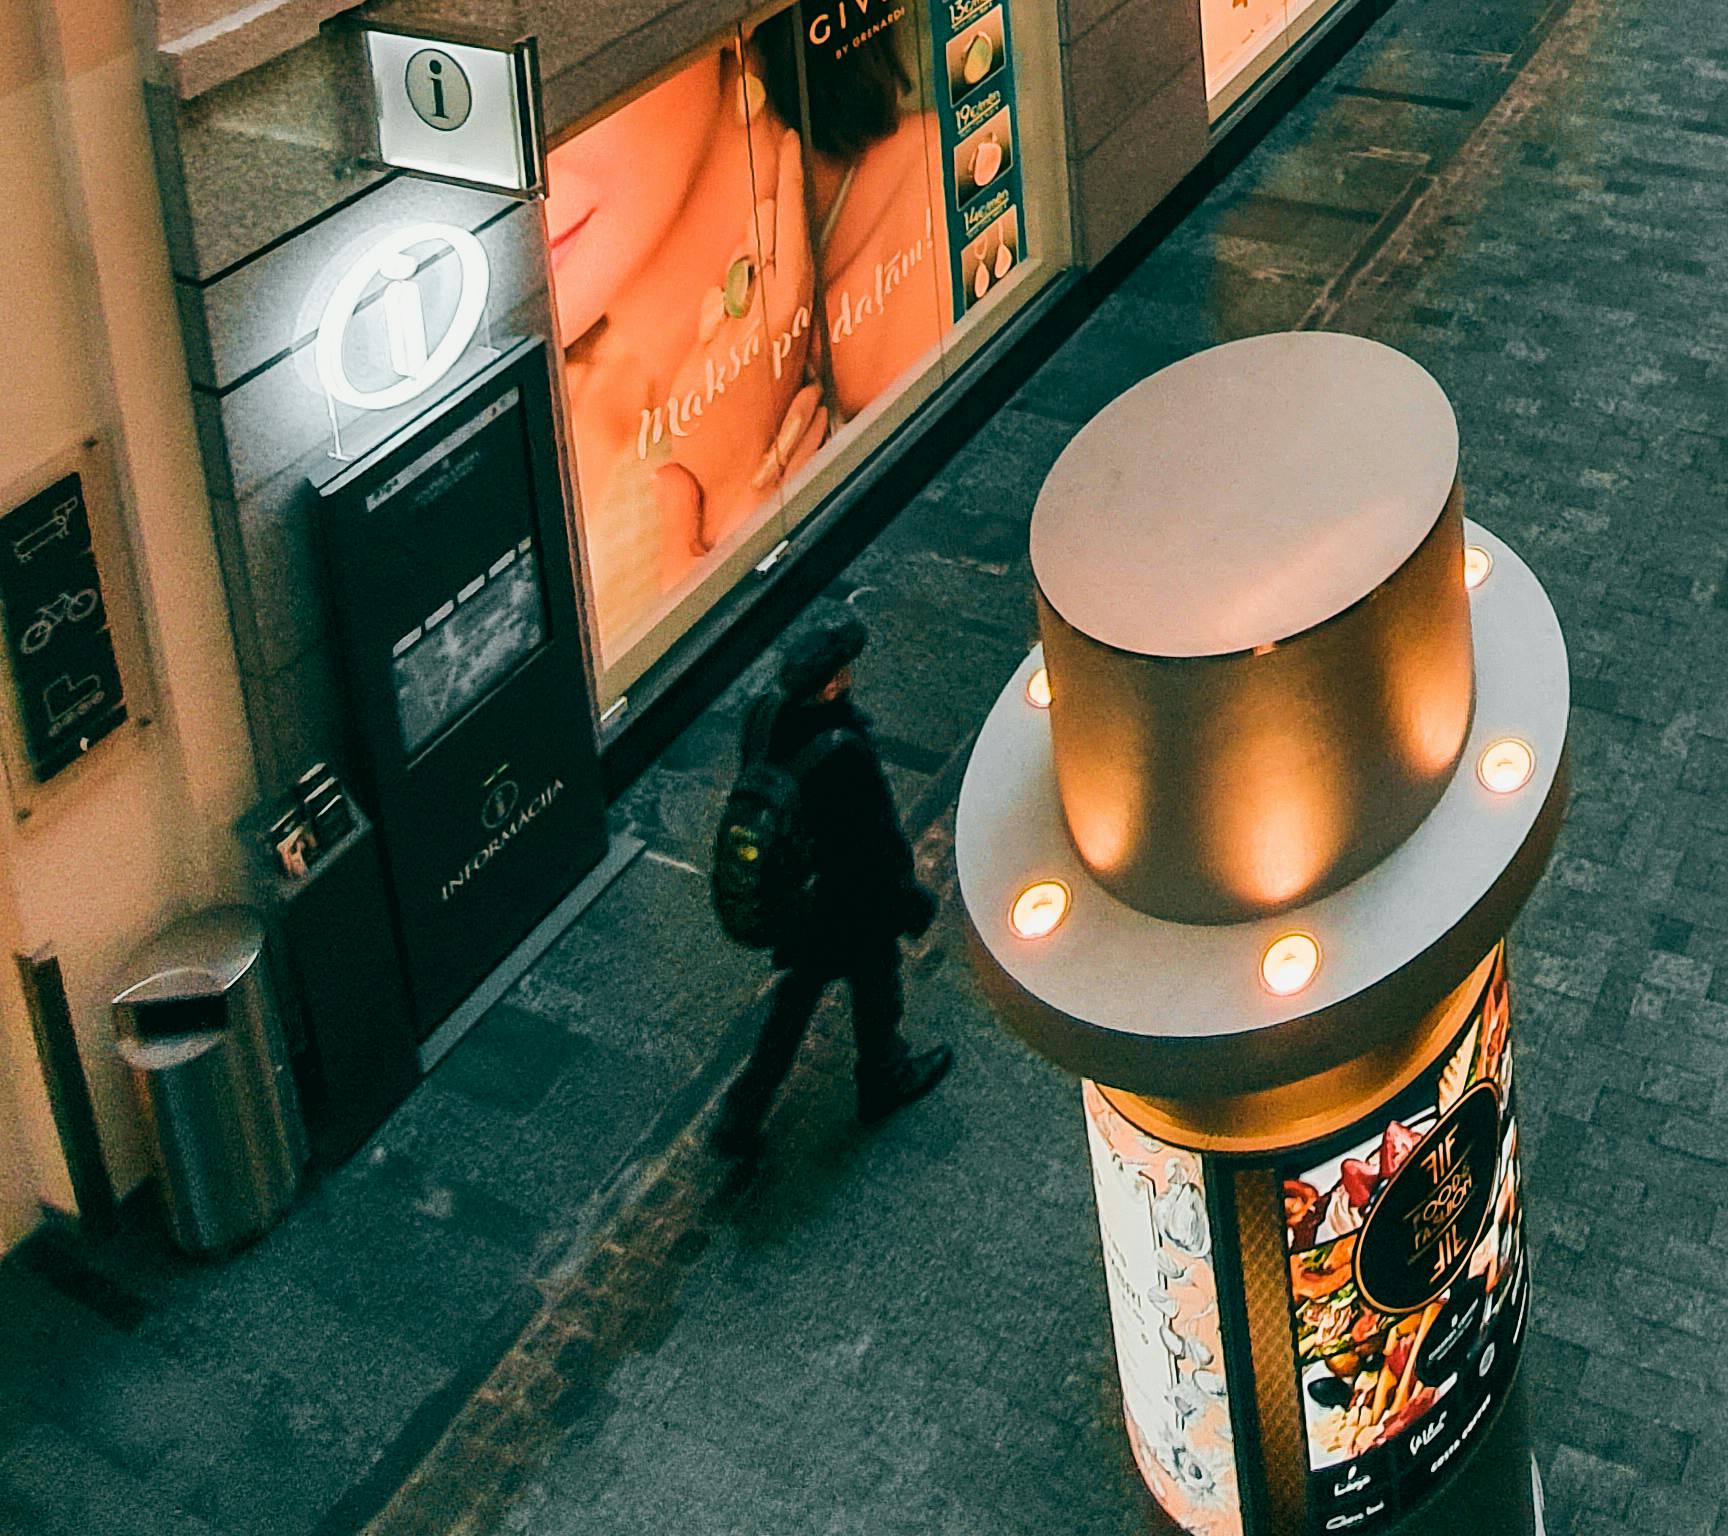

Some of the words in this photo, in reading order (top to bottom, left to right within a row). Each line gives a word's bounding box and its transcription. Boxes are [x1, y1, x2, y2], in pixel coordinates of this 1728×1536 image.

[835, 44, 849, 60] BY
[772, 306, 809, 379] pa
[1430, 1439, 1461, 1473] COSTA
